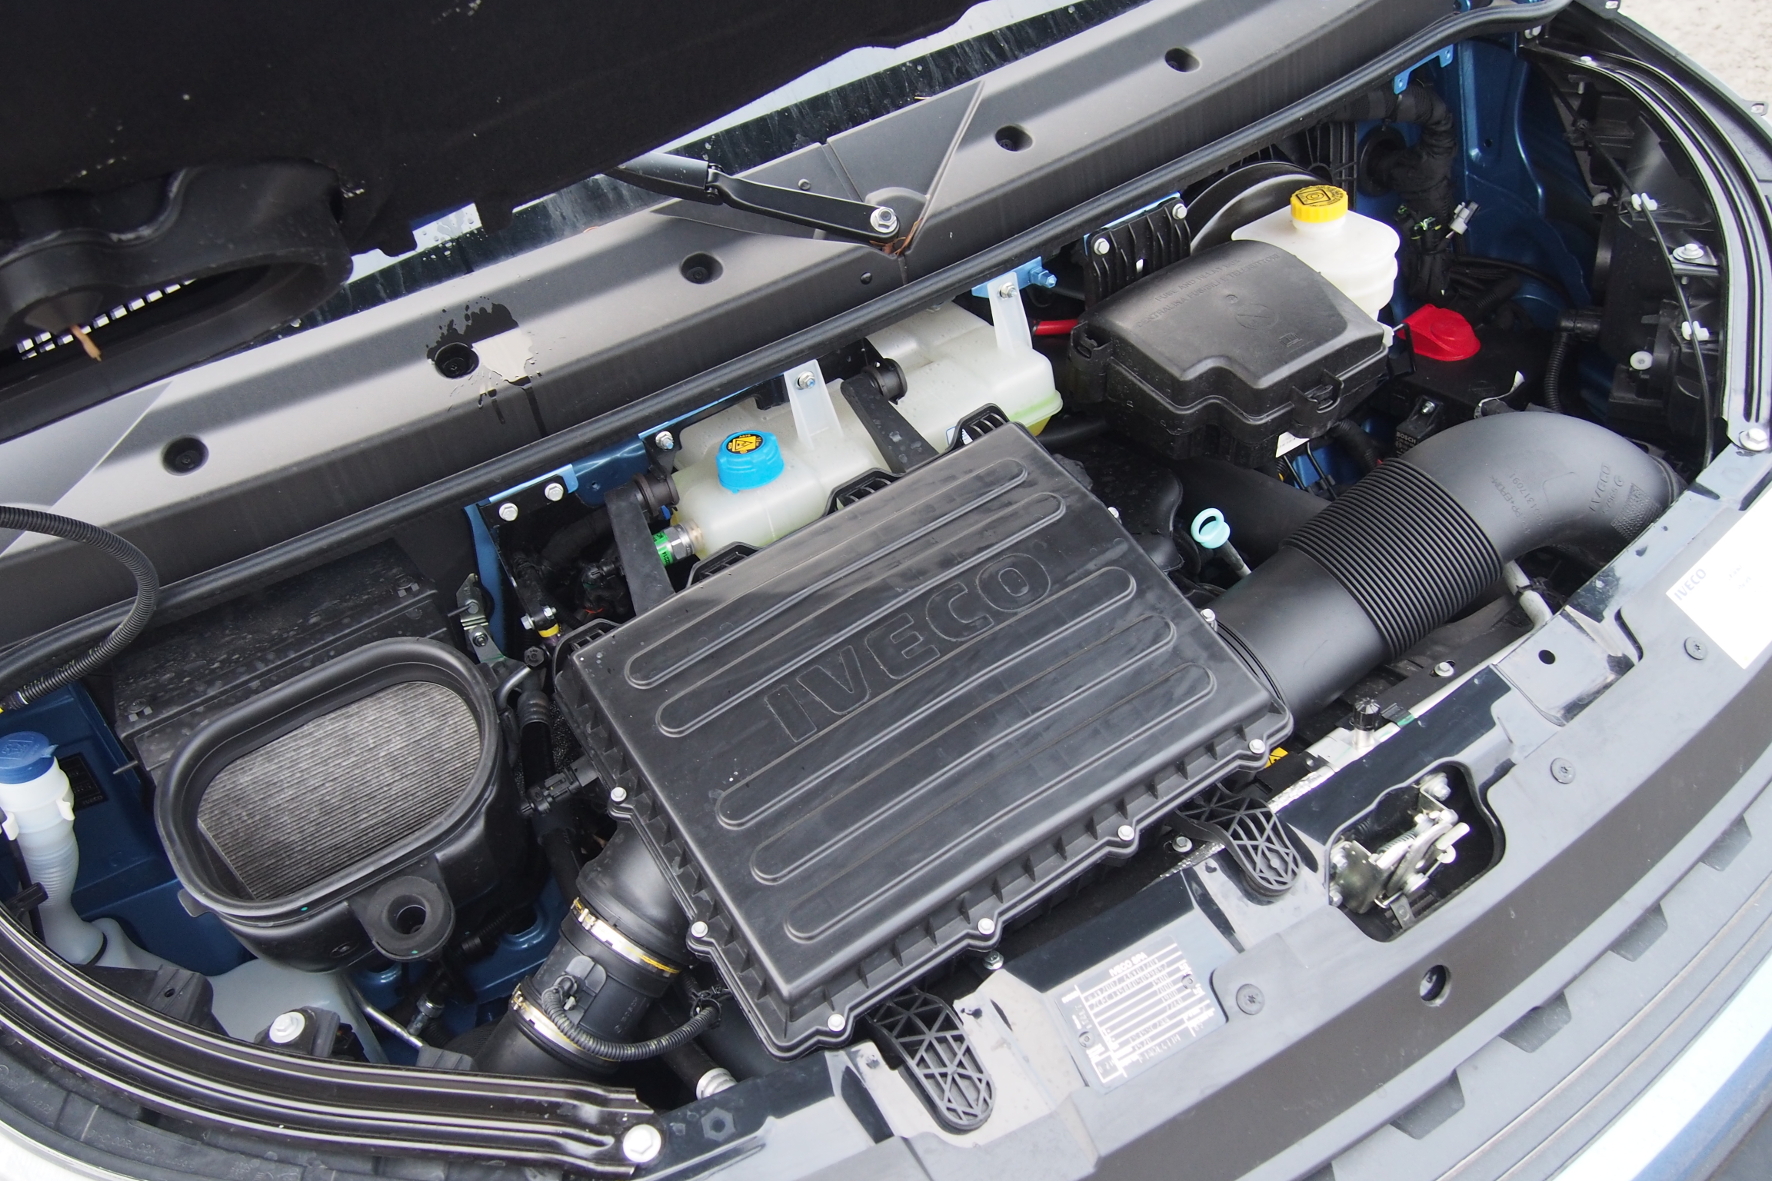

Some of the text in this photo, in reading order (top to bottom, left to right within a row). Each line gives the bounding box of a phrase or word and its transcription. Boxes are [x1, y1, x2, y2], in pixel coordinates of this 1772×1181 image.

[1178, 278, 1196, 291] AND
[1396, 431, 1417, 444] BOSCH
[1587, 462, 1610, 511] IVECO
[1674, 568, 1707, 601] IVECO
[764, 553, 1051, 742] IVECO
[1108, 958, 1132, 977] IVECO
